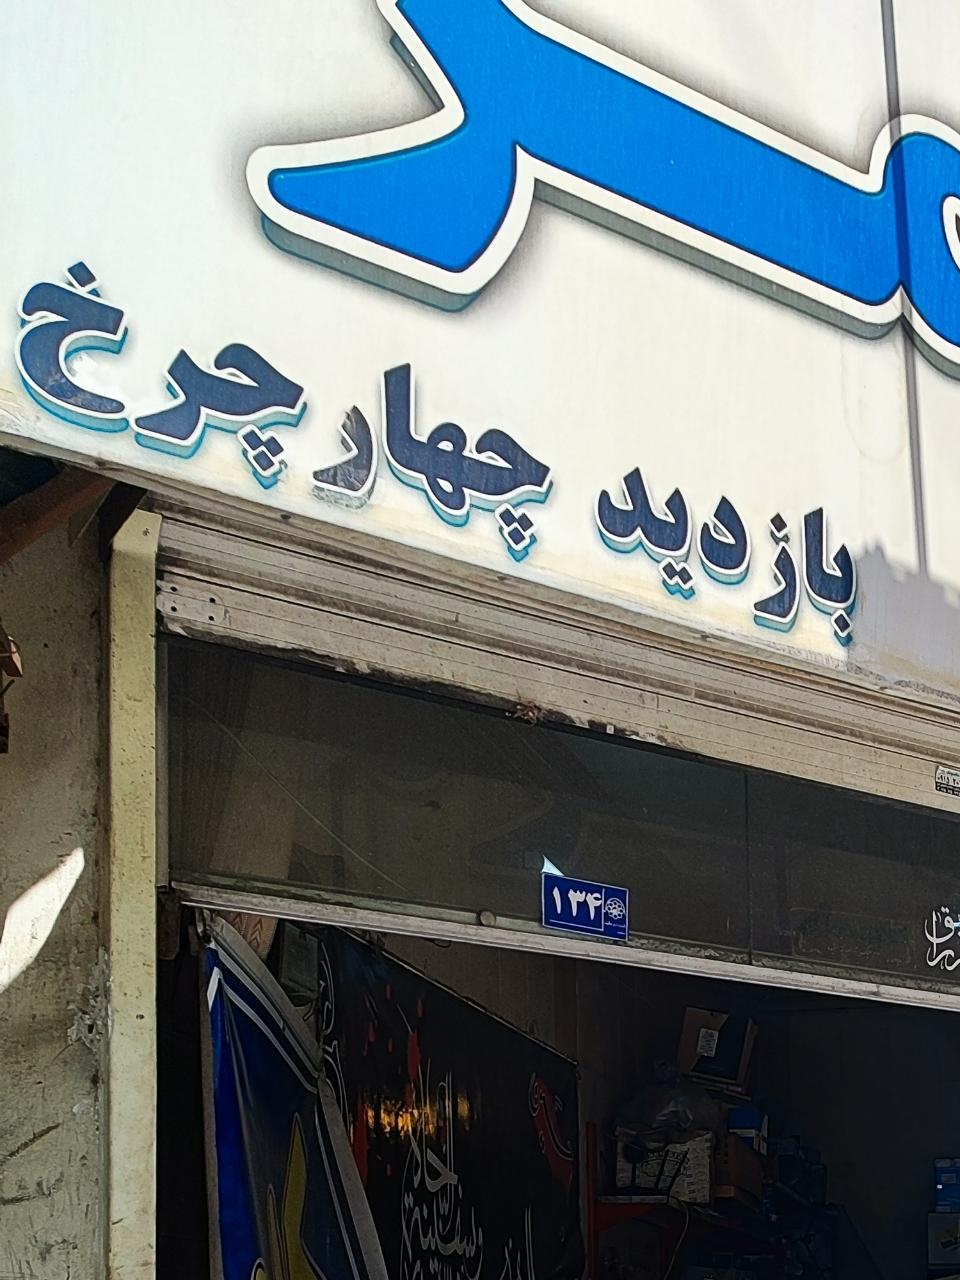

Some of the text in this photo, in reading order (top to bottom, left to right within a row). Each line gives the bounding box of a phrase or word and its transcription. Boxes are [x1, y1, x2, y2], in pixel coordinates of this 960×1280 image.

[15, 261, 858, 642] بازدید چهار چرخ
[552, 886, 603, 921] ۱۳۴
